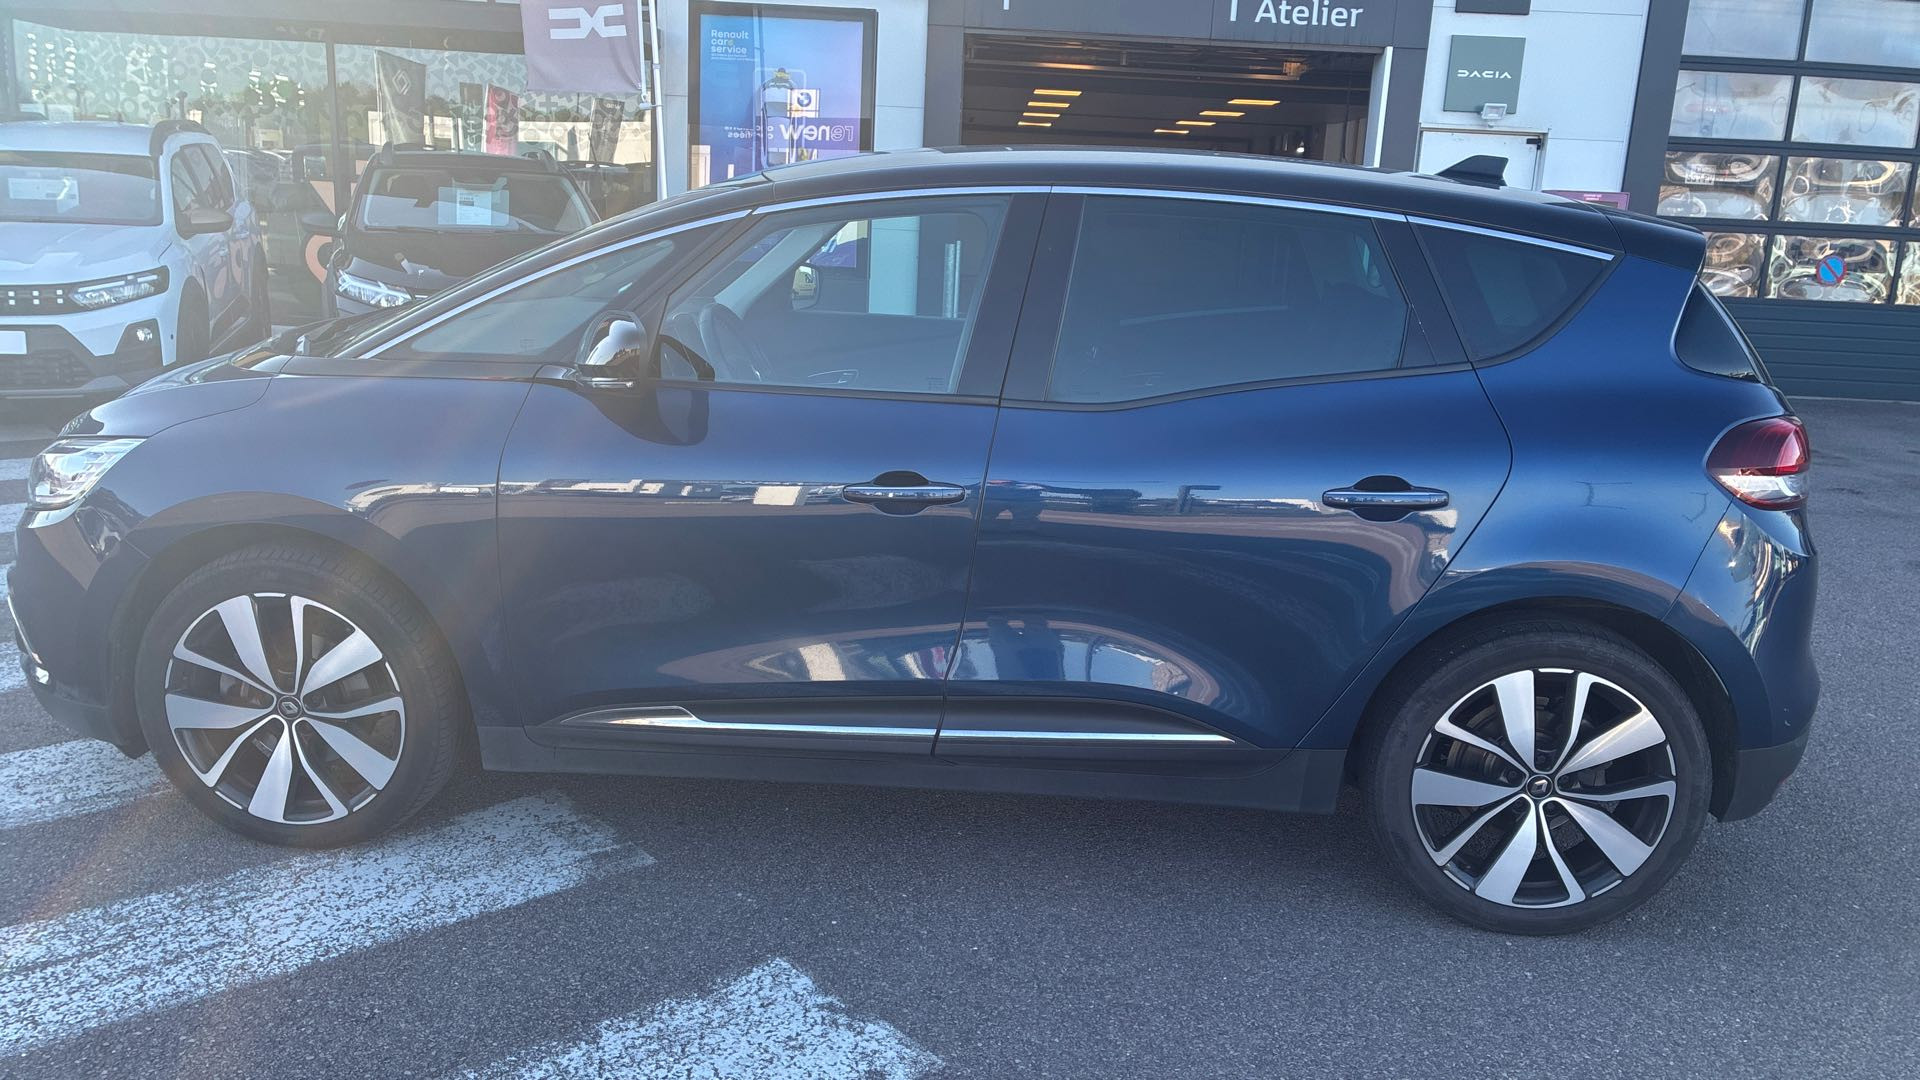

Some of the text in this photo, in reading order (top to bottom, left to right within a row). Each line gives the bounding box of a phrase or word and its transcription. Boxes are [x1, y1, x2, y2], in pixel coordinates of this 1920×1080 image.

[1254, 0, 1364, 27] Atelier
[711, 30, 749, 39] Renault
[711, 46, 747, 54] service
[1457, 69, 1512, 79] DACIA
